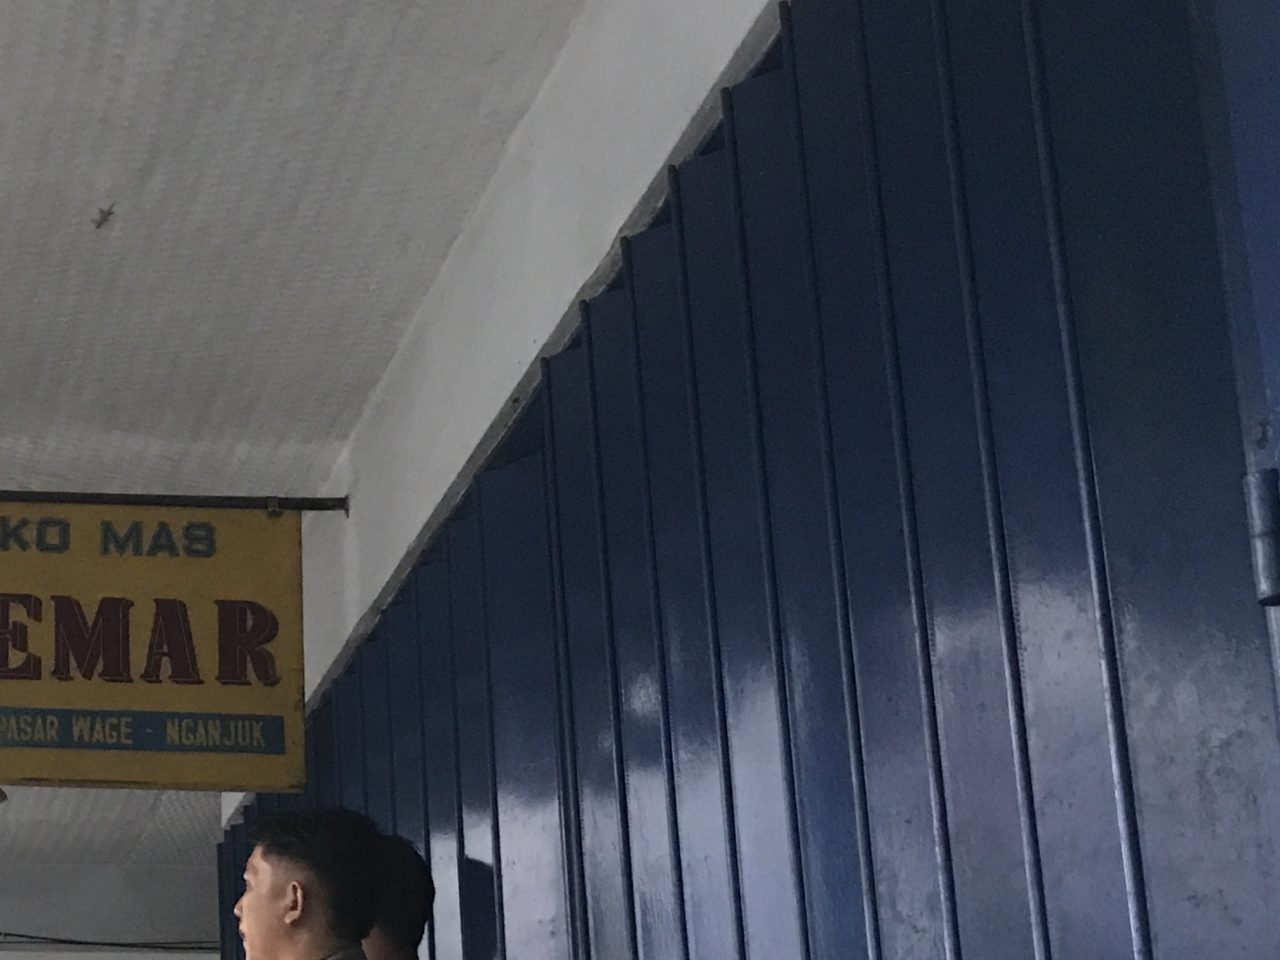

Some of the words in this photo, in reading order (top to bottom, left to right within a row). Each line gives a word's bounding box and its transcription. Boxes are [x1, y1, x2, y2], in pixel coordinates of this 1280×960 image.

[100, 520, 217, 558] MAS
[71, 716, 134, 746] WAGE
[166, 718, 265, 749] NGANJUK
